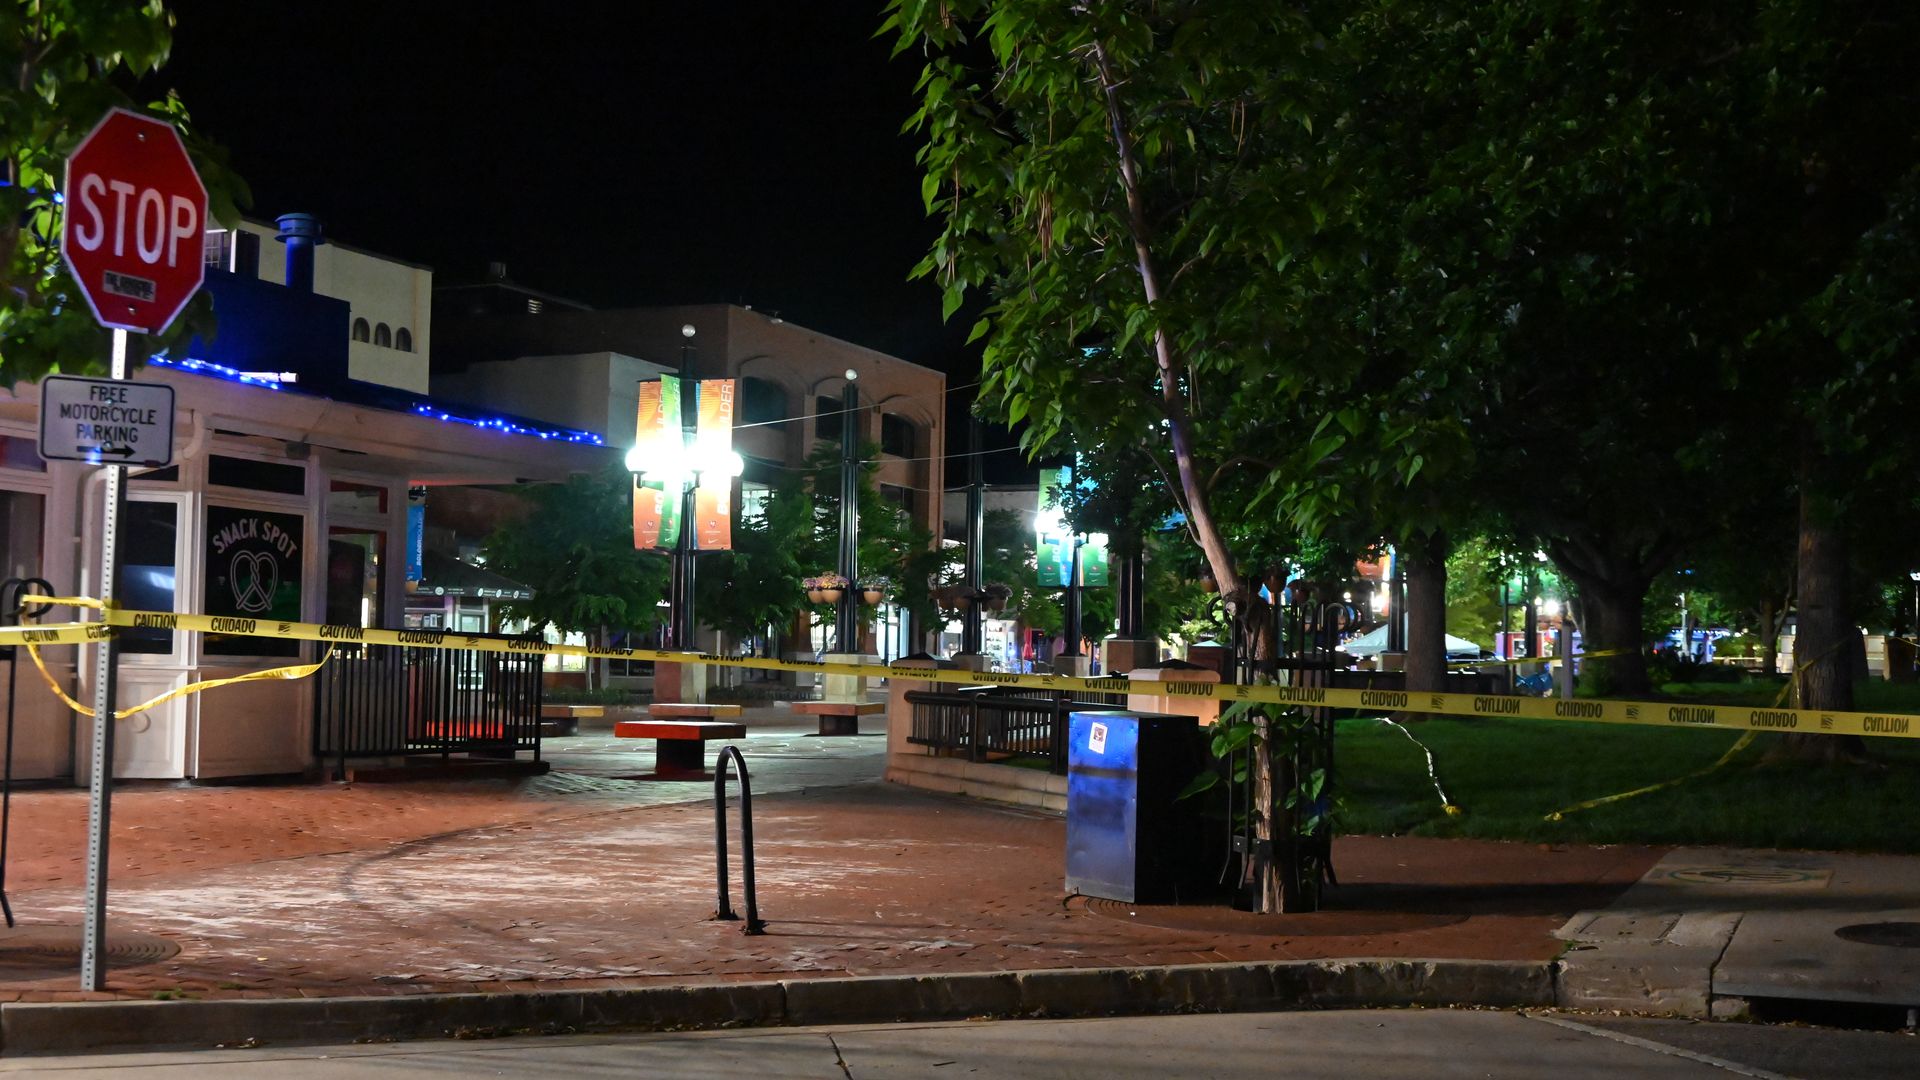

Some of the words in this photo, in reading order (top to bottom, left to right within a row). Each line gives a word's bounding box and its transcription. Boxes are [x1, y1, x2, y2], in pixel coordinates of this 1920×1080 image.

[75, 173, 198, 268] STOP
[90, 386, 128, 403] FREE
[60, 403, 157, 425] MOTORCYCLE
[76, 424, 138, 443] PARKING
[213, 518, 259, 555] SNACK
[262, 521, 298, 559] SPOT
[22, 629, 60, 642] CAUTION
[134, 613, 178, 630] CAUTION
[211, 617, 256, 633] CUIDADO
[319, 624, 364, 640] CAUTION
[398, 631, 444, 645] CUIDADO
